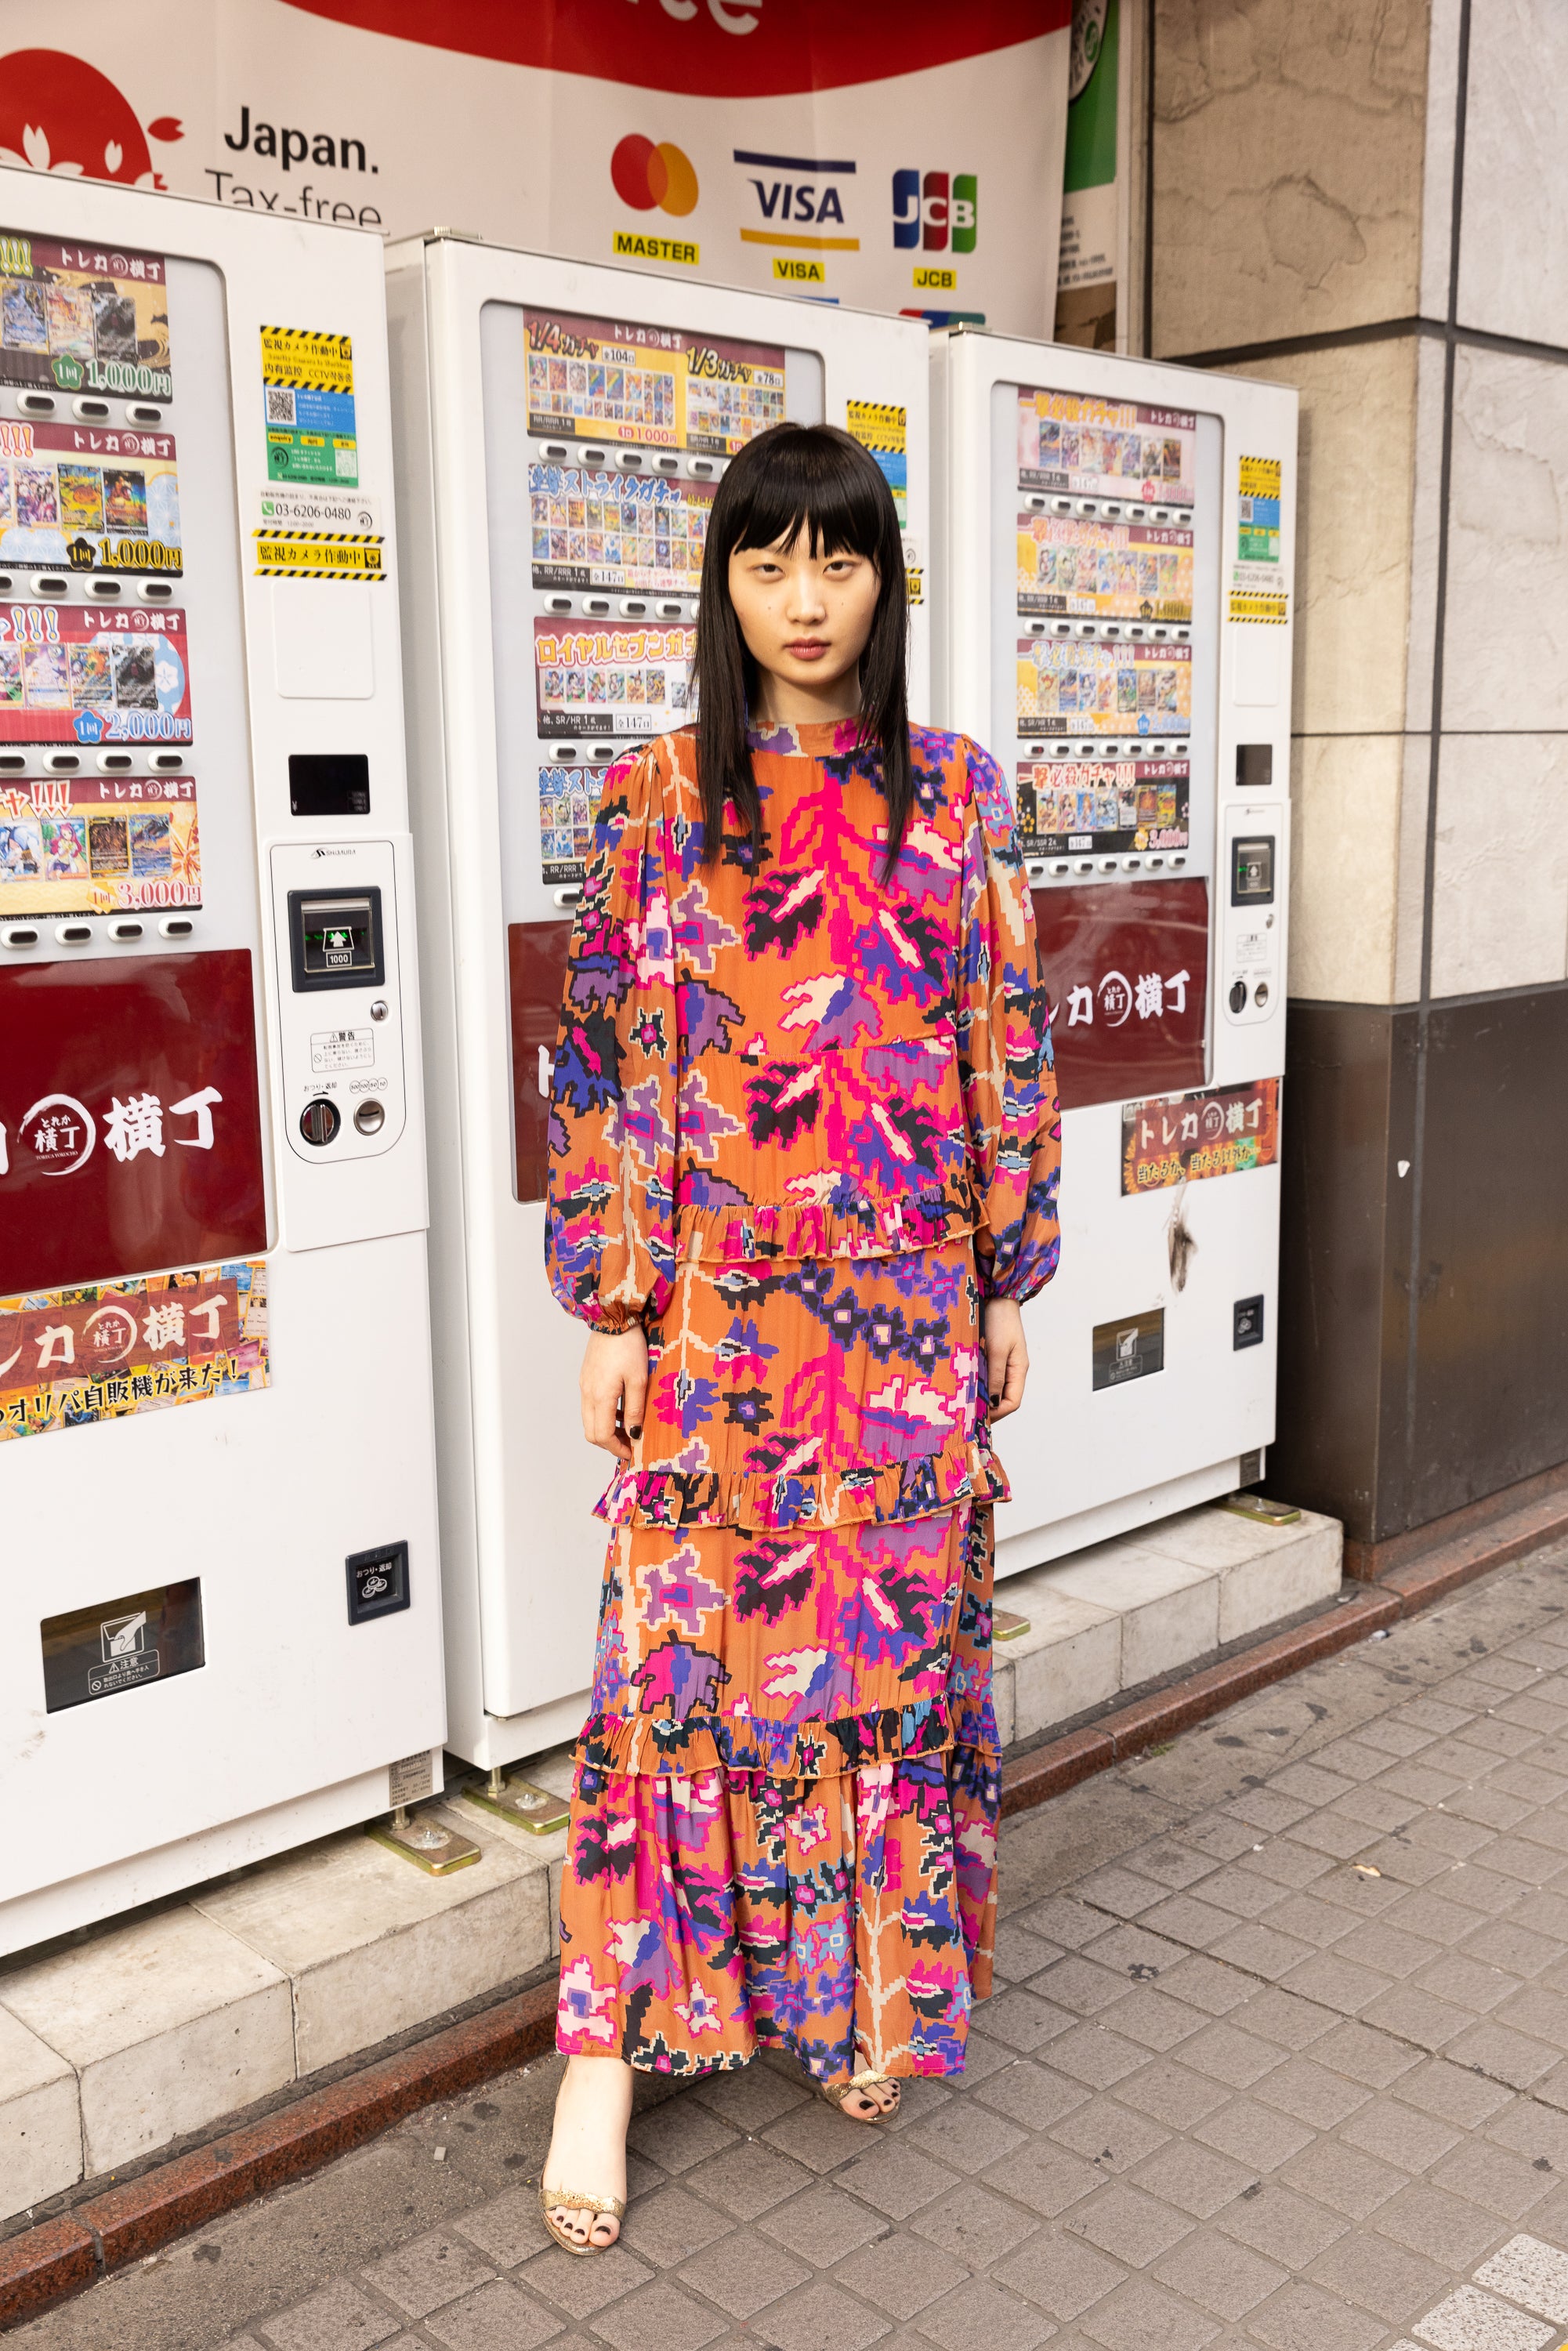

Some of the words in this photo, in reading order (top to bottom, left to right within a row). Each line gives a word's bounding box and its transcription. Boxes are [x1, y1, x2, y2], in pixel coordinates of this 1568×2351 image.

[224, 105, 378, 174] Japan.
[748, 179, 845, 224] VISA
[617, 234, 696, 263] MASTER
[777, 261, 820, 281] VISA
[917, 270, 953, 288] JCB
[263, 338, 338, 357] 監視カメラ作動中
[276, 503, 351, 520] 03-6206-0480
[260, 545, 360, 564] 監視カメラ作動中
[329, 954, 349, 964] 1000
[34, 1126, 80, 1153] 横丁
[0, 1359, 238, 1423] オリパ自販機が来た!
[357, 1562, 392, 1578] おつり・返却
[120, 1657, 139, 1669] 注意
